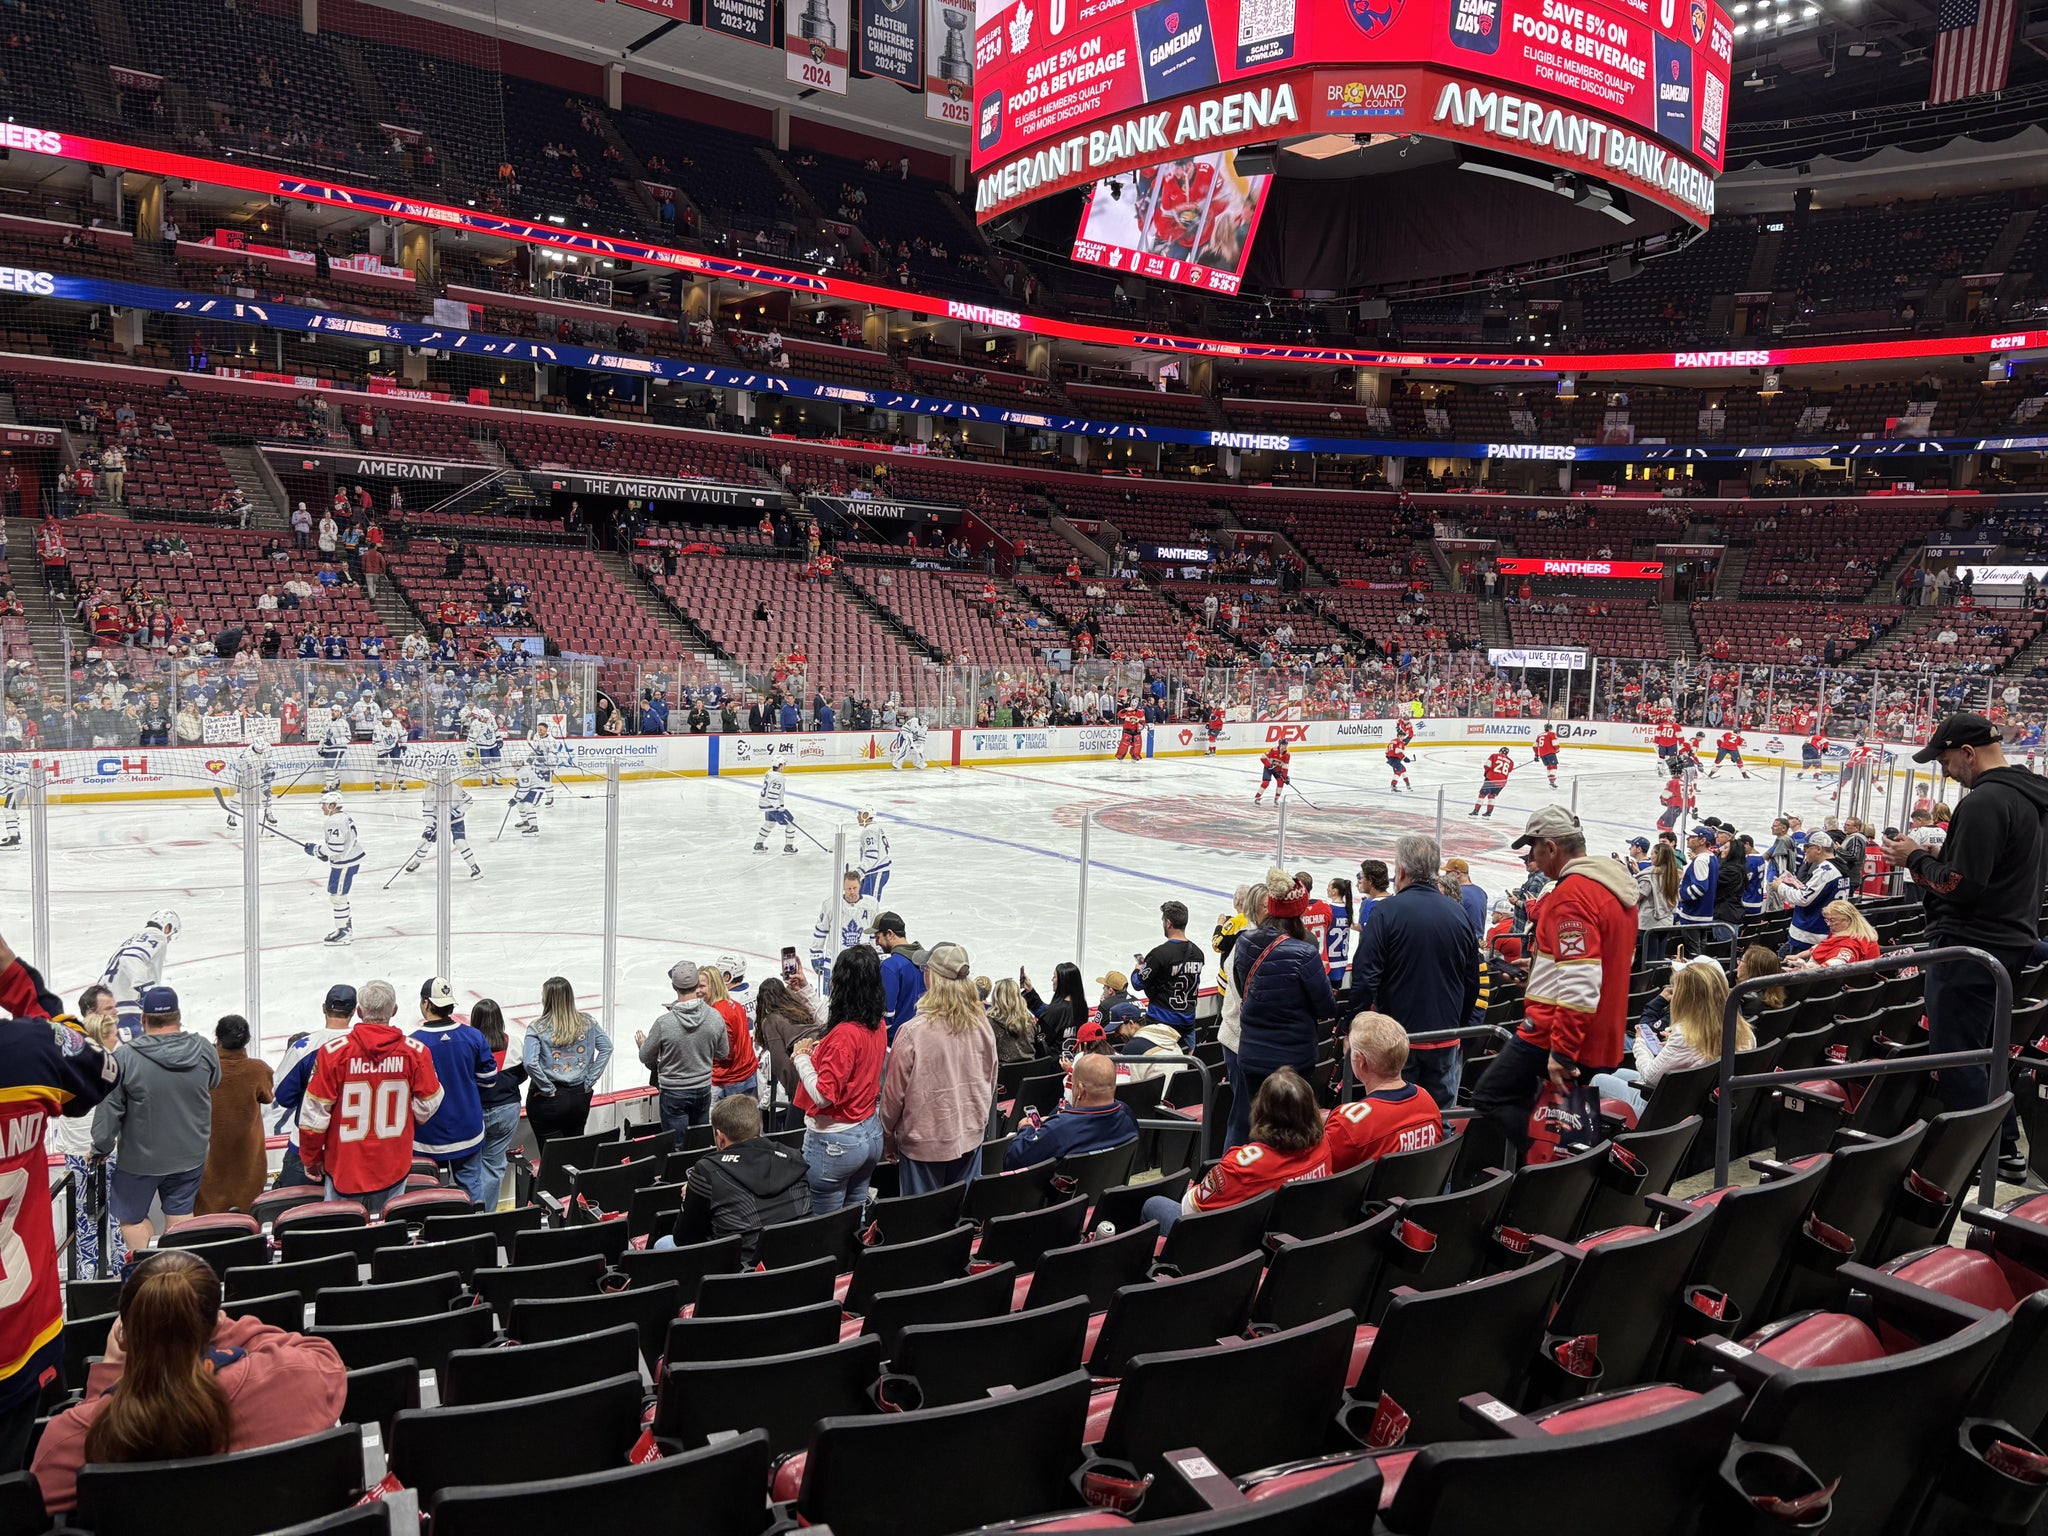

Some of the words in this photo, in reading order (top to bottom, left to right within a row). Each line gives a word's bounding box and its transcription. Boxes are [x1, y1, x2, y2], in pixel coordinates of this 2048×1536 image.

[1459, 0, 1496, 18] GAME
[720, 12, 757, 34] 2023-24
[874, 13, 908, 31] EASTERN
[1456, 13, 1479, 34] DAY
[1543, 0, 1584, 30] SAVE
[1585, 11, 1606, 39] 5%
[1608, 24, 1628, 48] ON
[867, 26, 915, 51] CONFERENCE
[1149, 24, 1203, 67] GAMEDAY
[1250, 44, 1268, 54] SCAN
[1269, 42, 1279, 50] TO
[1513, 13, 1559, 45] FOOD
[1561, 30, 1573, 50] &
[1575, 34, 1646, 80] BEVERAGE
[868, 40, 913, 63] CHAMPIONS
[1026, 56, 1058, 84] SAVE
[1059, 46, 1078, 71] 5%
[1079, 36, 1101, 58] ON
[1245, 48, 1284, 63] DOWNLOAD
[875, 56, 907, 75] 2024-25
[1523, 46, 1562, 68] ELIGIBLE
[1563, 59, 1603, 81] MEMBERS
[1605, 73, 1635, 95] QUALIFY
[802, 64, 831, 87] 2024
[1008, 88, 1039, 114] FOOD
[1039, 80, 1050, 98] &
[1051, 49, 1126, 93] BEVERAGE
[1535, 65, 1553, 80] FOR
[1555, 70, 1579, 88] MORE
[1581, 76, 1625, 105] DISCOUNTS
[1328, 83, 1407, 102] BROWARD
[1660, 83, 1689, 102] GAMEDAY
[942, 102, 969, 122] 2025
[982, 101, 1000, 124] GAME
[1015, 107, 1042, 128] ELIGIBLE
[1042, 94, 1078, 115] MEMBERS
[1078, 79, 1113, 101] QUALIFY
[1365, 99, 1404, 108] COUNTY
[1023, 122, 1036, 136] FOR
[1036, 113, 1056, 131] MORE
[1057, 97, 1101, 122] DISCOUNTS
[975, 134, 1088, 212] AMERANT
[1089, 110, 1171, 167] BANK
[1173, 83, 1298, 145] ARENA
[1434, 82, 1607, 161] AMERANT
[1604, 128, 1666, 190] BANK
[1663, 155, 1715, 216] ARENA
[1130, 252, 1141, 271] 0
[1169, 261, 1180, 280] 0
[948, 301, 1021, 329] PANTHERS
[1990, 336, 2012, 349] 6:32
[2012, 335, 2026, 347] PM
[1675, 350, 1769, 368] PANTHERS
[34, 432, 55, 446] 133
[1210, 430, 1290, 451] PANTHERS
[1487, 444, 1576, 460] PANTHERS
[357, 460, 444, 481] AMERANT
[584, 479, 610, 495] THE
[614, 482, 688, 501] AMERANT
[690, 488, 738, 504] VAULT
[847, 502, 905, 519] AMERANT
[1157, 548, 1208, 561] PANTHERS
[1478, 541, 1492, 550] 107
[1664, 548, 1678, 556] 107
[1701, 548, 1714, 557] 108
[1927, 549, 1943, 557] 108
[1544, 561, 1611, 575] PANTHERS
[985, 734, 1008, 743] TROPICAL
[1025, 733, 1046, 742] TROPICAL
[1079, 729, 1121, 741] COMCAST
[1265, 724, 1310, 743] DEX
[1337, 724, 1383, 736] AutoNation
[1485, 725, 1531, 735] AMAZING
[1661, 727, 1674, 738] 40
[1729, 734, 1737, 743] 2
[578, 745, 623, 757] Broward
[624, 744, 657, 755] Health
[985, 742, 1009, 750] FINANCIAL
[1025, 741, 1048, 750] FINANCIAL
[1079, 741, 1119, 750] BUSINESS
[1538, 736, 1545, 747] 6
[97, 756, 147, 776] CH
[1493, 761, 1510, 776] 26
[82, 776, 116, 785] Cooper
[131, 774, 163, 783] Hunter
[771, 782, 782, 791] 23
[327, 828, 340, 838] 74
[1863, 861, 1877, 882] 9
[861, 909, 869, 920] A
[1328, 927, 1350, 958] 23
[350, 1055, 404, 1075] McCANN
[339, 1079, 410, 1143] 90
[1790, 1098, 1799, 1110] 9
[1400, 1124, 1437, 1152] GREER
[721, 1154, 741, 1163] UFC
[1235, 1145, 1264, 1167] 9
